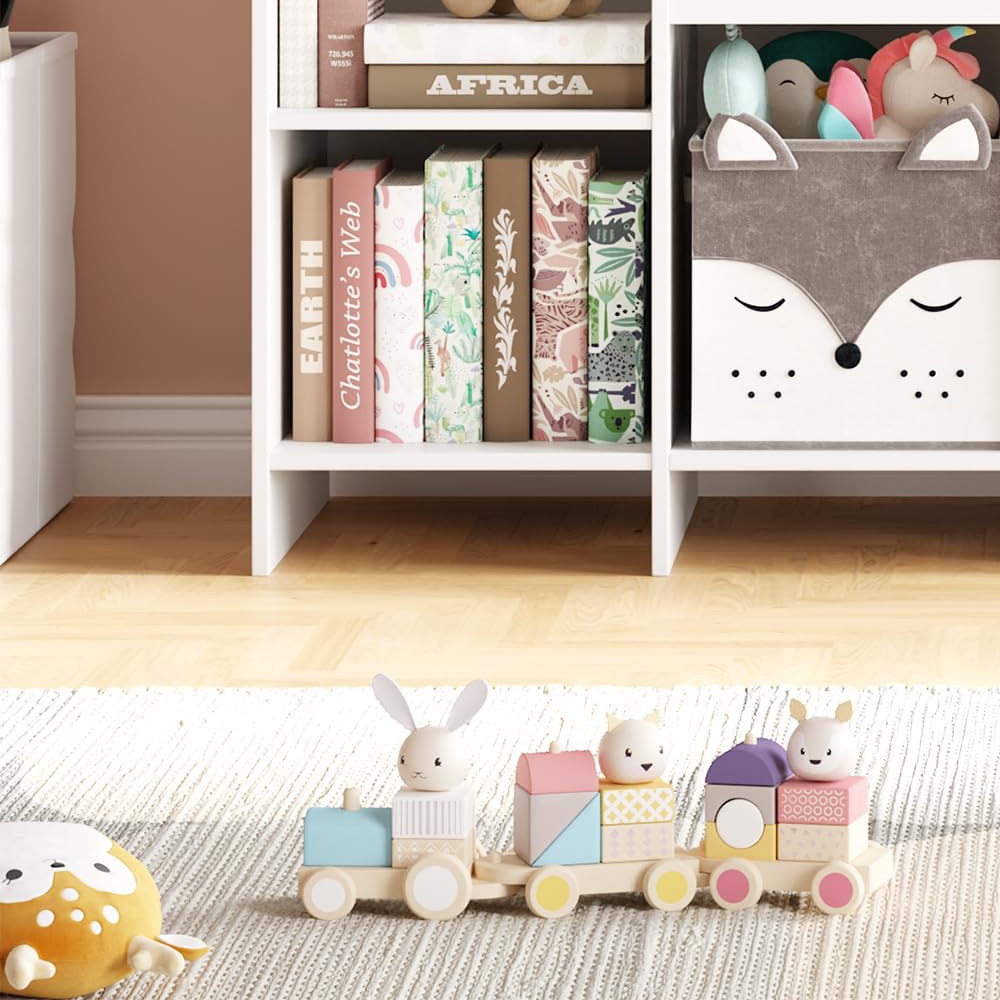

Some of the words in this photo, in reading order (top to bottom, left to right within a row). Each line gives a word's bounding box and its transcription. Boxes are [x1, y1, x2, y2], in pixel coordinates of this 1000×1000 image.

[328, 50, 354, 58] 720.945
[426, 74, 593, 96] AFRICA
[340, 201, 361, 258] Web
[300, 240, 324, 374] EARTH
